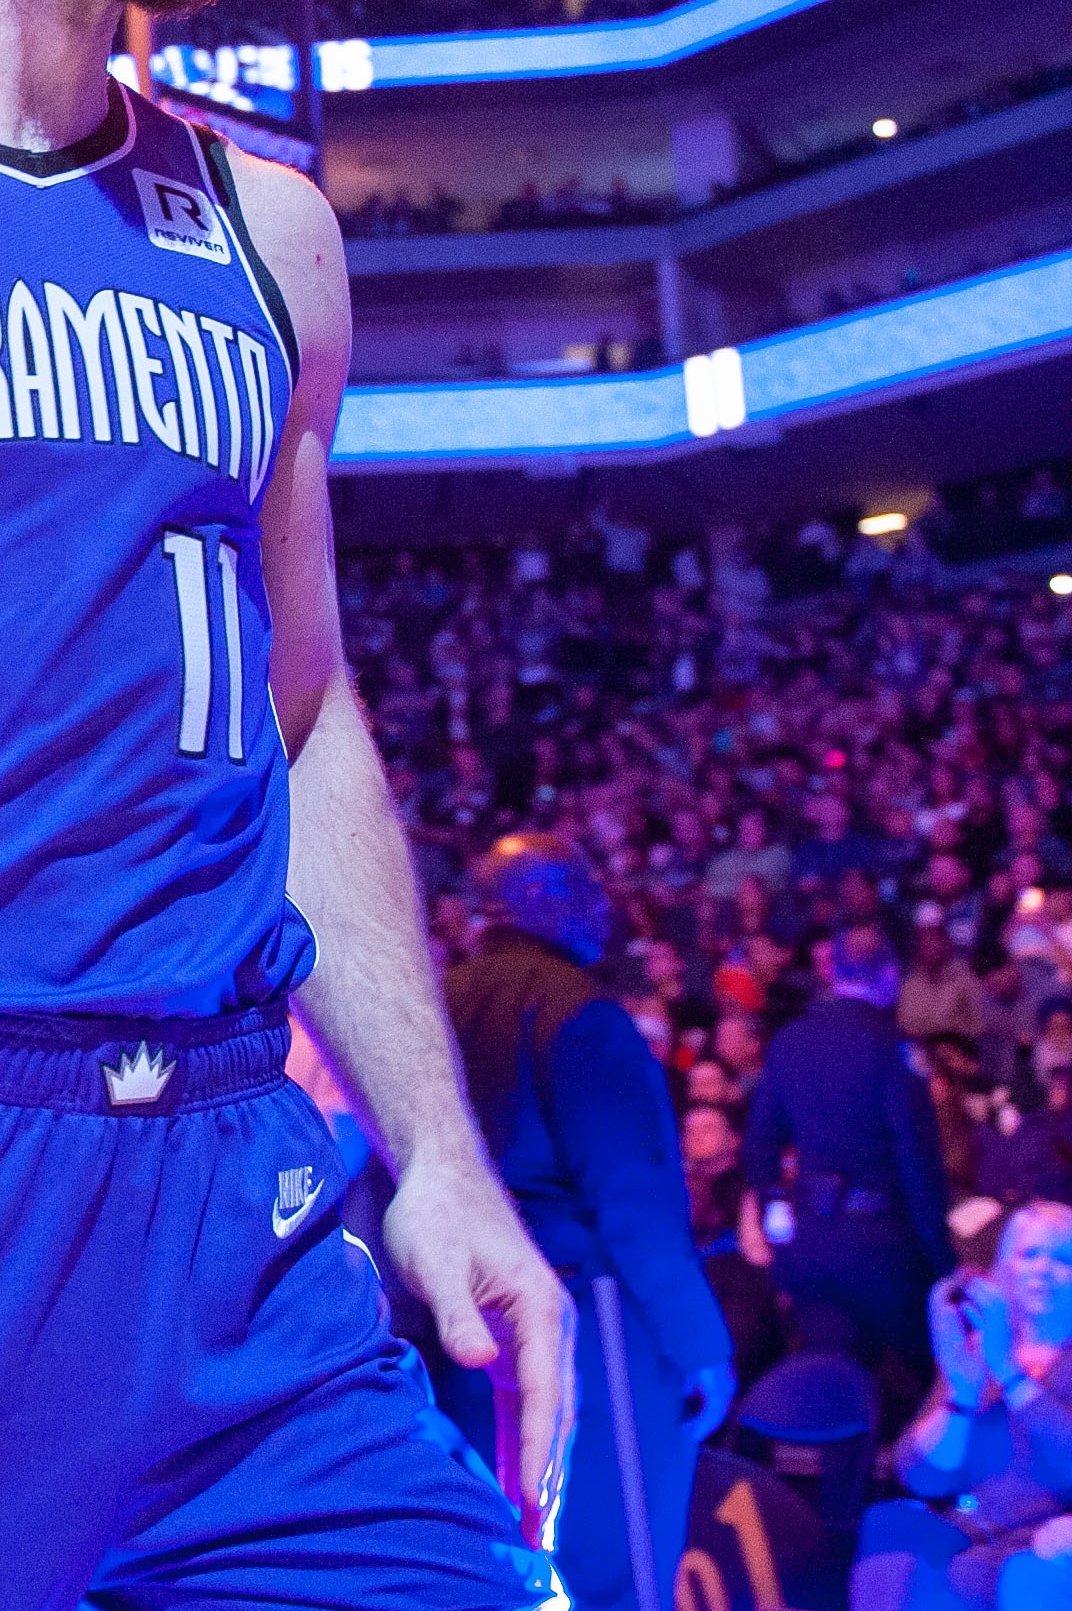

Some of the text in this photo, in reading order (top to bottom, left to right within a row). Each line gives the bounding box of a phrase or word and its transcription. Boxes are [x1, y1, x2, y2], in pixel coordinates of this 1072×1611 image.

[153, 182, 209, 232] R
[153, 228, 225, 255] REVIVER
[161, 525, 247, 767] 11
[277, 1165, 313, 1210] NIKE
